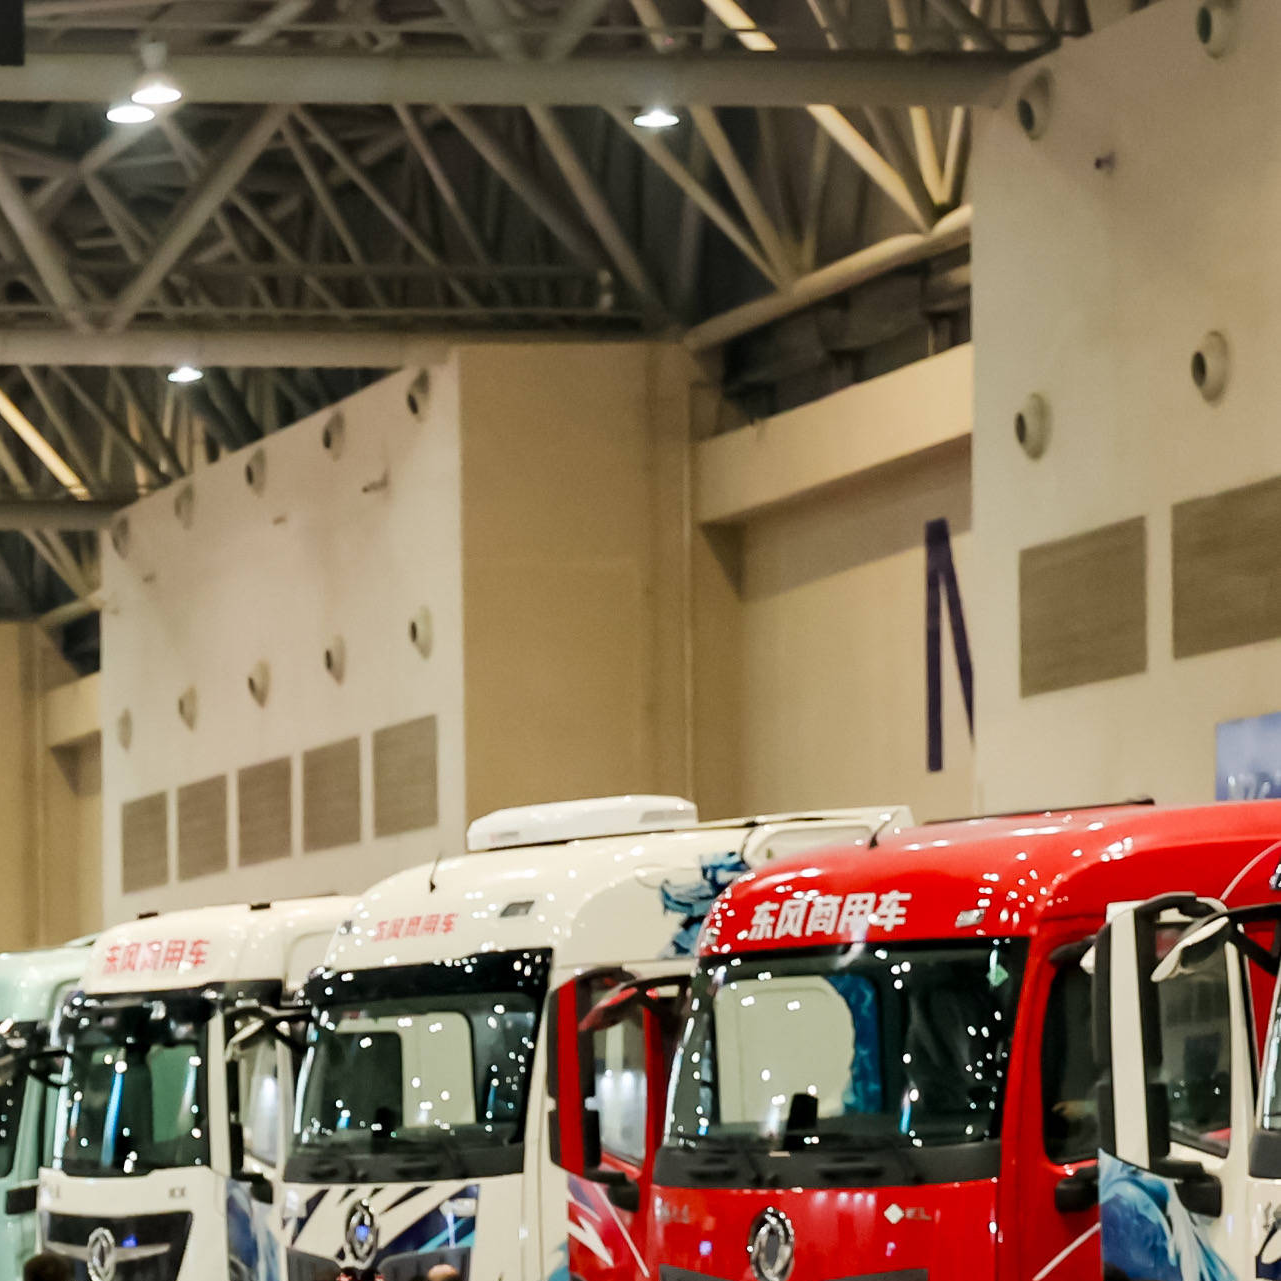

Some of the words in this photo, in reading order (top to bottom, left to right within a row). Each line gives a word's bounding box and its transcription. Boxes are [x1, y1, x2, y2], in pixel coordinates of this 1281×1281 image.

[747, 889, 913, 942] 东风商用车
[102, 939, 210, 974] 东风商用车
